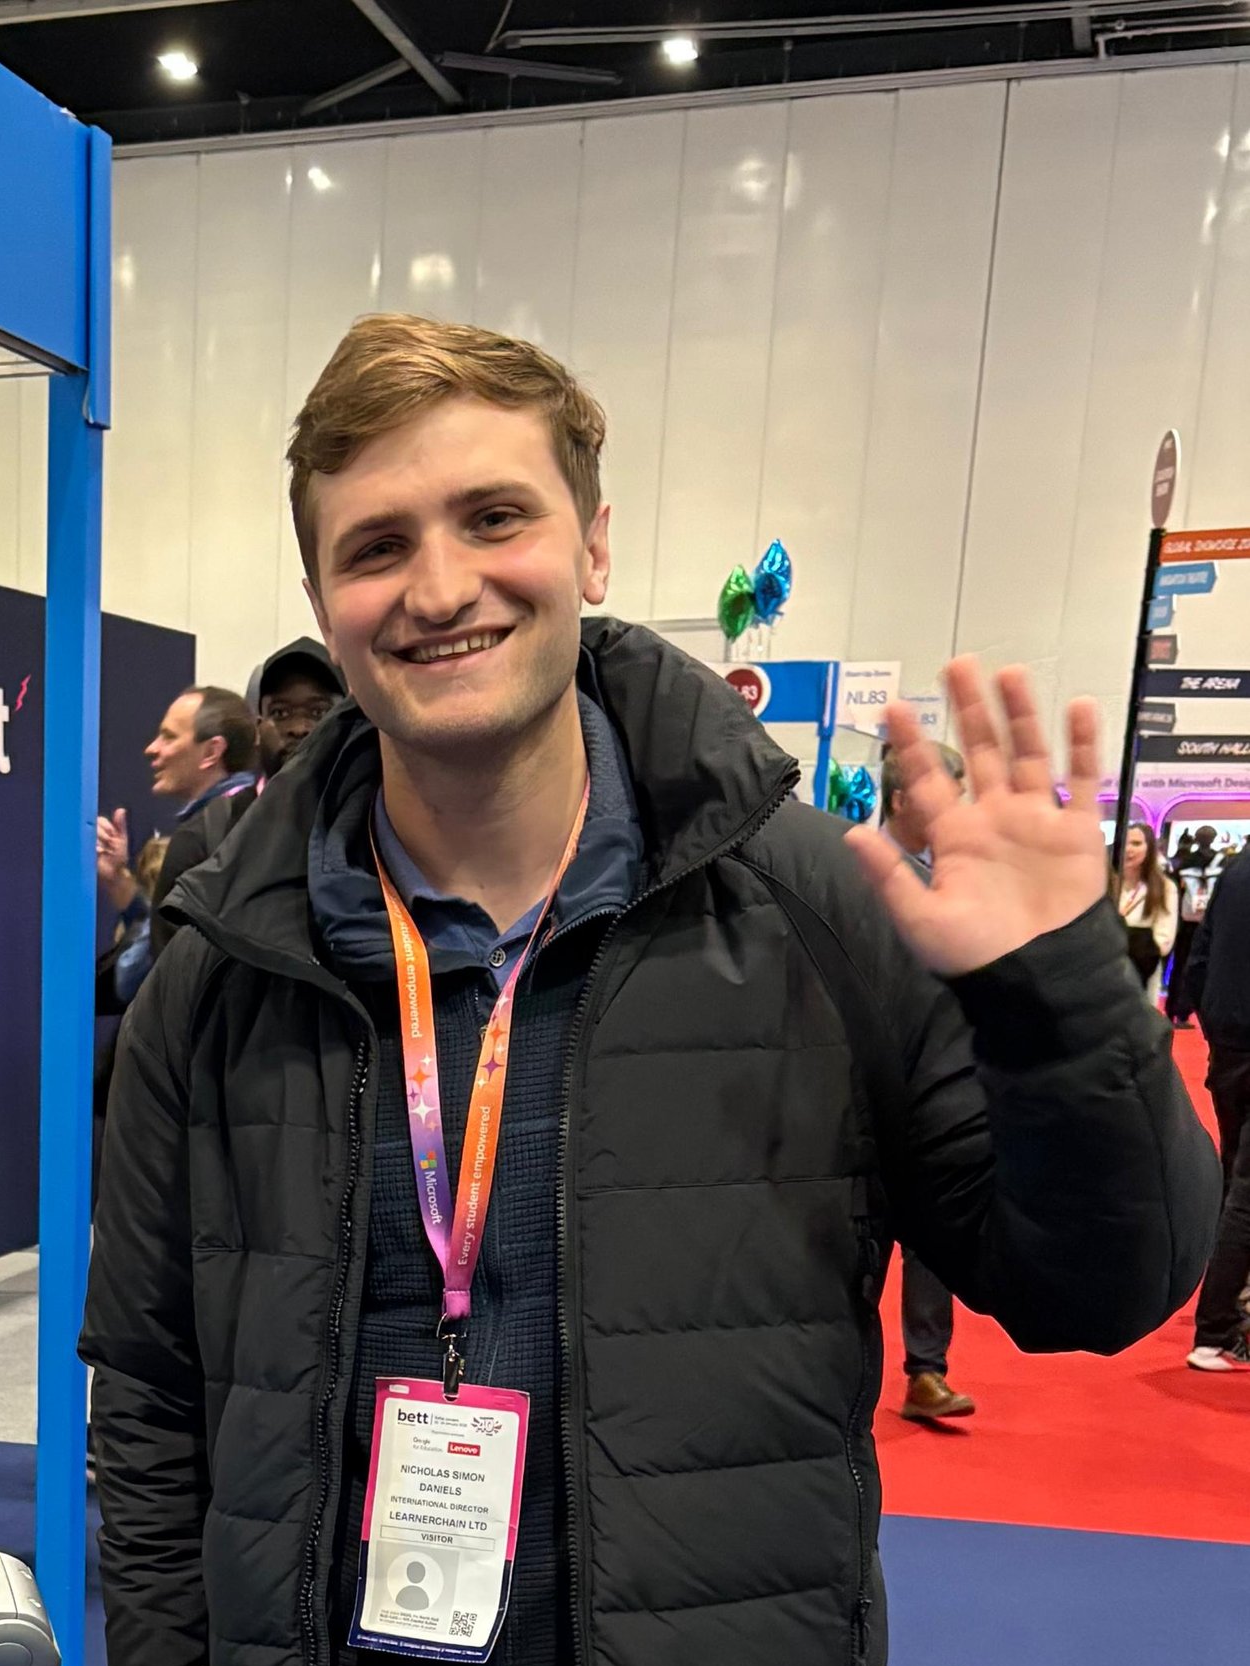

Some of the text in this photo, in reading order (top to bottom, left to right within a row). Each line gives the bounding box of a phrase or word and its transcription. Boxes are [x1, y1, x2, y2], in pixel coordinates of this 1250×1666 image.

[847, 690, 887, 705] NL83
[1177, 741, 1220, 755] SOUTH
[1142, 778, 1166, 788] with
[1169, 777, 1222, 788] Microsoft
[406, 965, 422, 1038] empowered
[458, 1106, 491, 1266] Every student empowered
[424, 1171, 443, 1225] Microsoft
[397, 1408, 429, 1424] bett
[450, 1443, 478, 1454] Lenovo
[400, 1464, 485, 1482] NICHOLAS SIMON
[419, 1483, 462, 1496] DANIELS
[390, 1496, 489, 1514] INTERNATIONAL DIRECTOR
[390, 1511, 487, 1531] LEARNERCHAIN LTD
[421, 1533, 453, 1544] VISITOR
